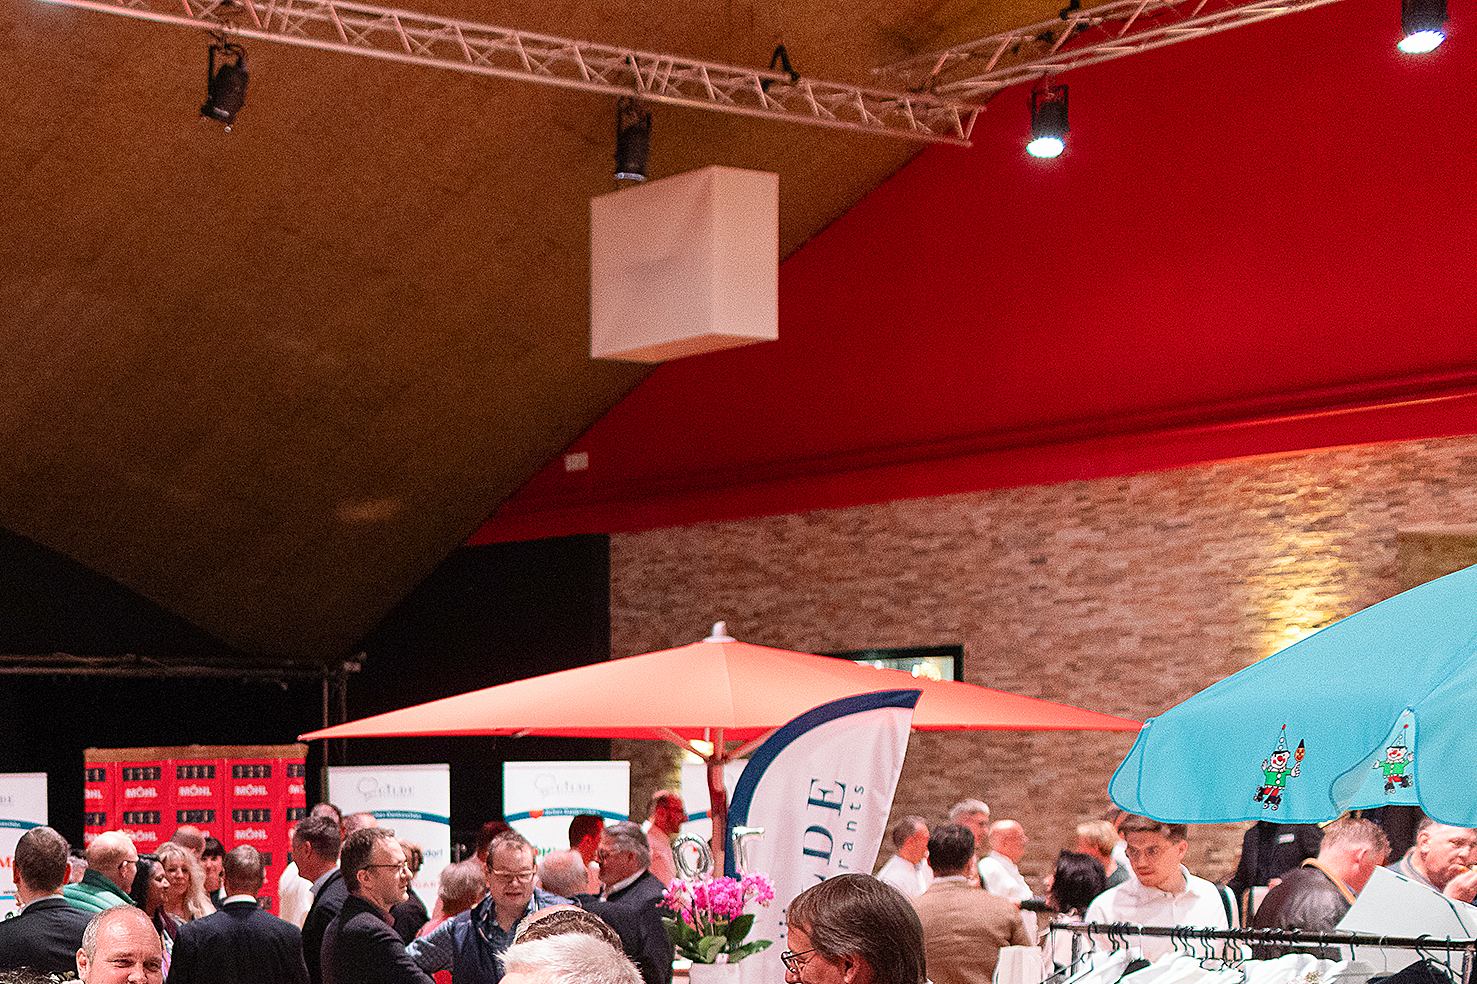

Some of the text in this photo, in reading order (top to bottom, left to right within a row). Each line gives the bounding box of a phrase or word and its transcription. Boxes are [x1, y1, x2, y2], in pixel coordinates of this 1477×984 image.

[125, 786, 158, 798] MÖHL
[178, 784, 212, 796] MÖHL
[234, 784, 268, 796] MÖHL
[234, 828, 268, 839] MÖHL
